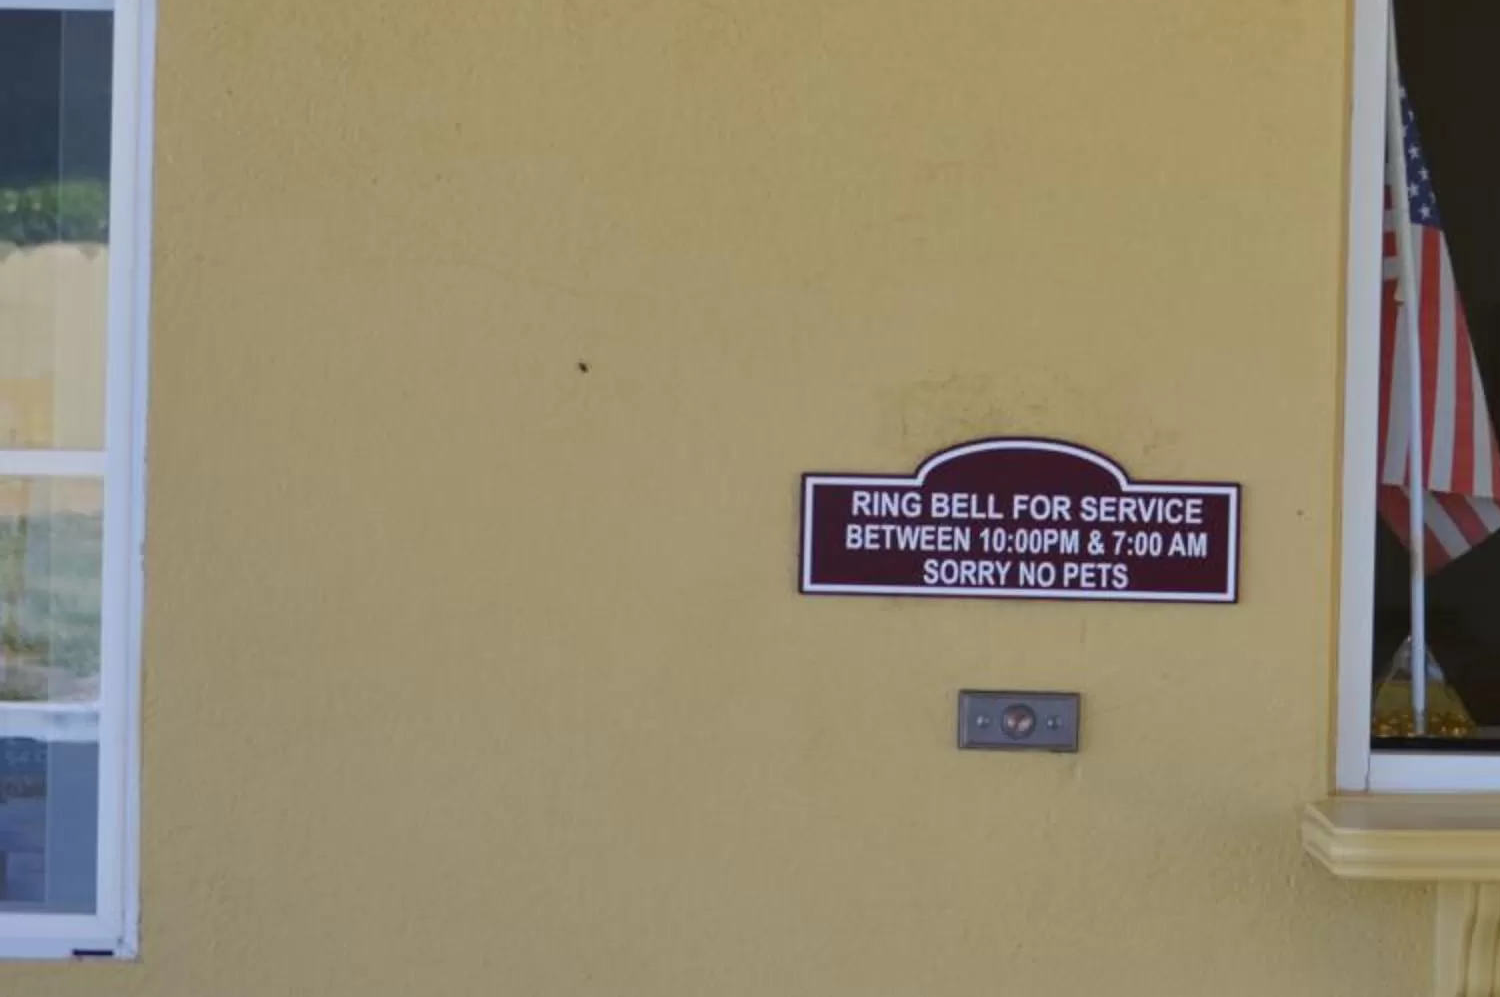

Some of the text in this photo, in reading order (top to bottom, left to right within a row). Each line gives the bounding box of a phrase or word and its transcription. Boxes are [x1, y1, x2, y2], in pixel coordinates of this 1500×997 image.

[852, 490, 1204, 523] RING BELL FOR SERVICE
[845, 525, 1208, 557] BETWEEN 10:00PM & 7:00 AM
[923, 559, 1129, 588] SORRY NO PETS
